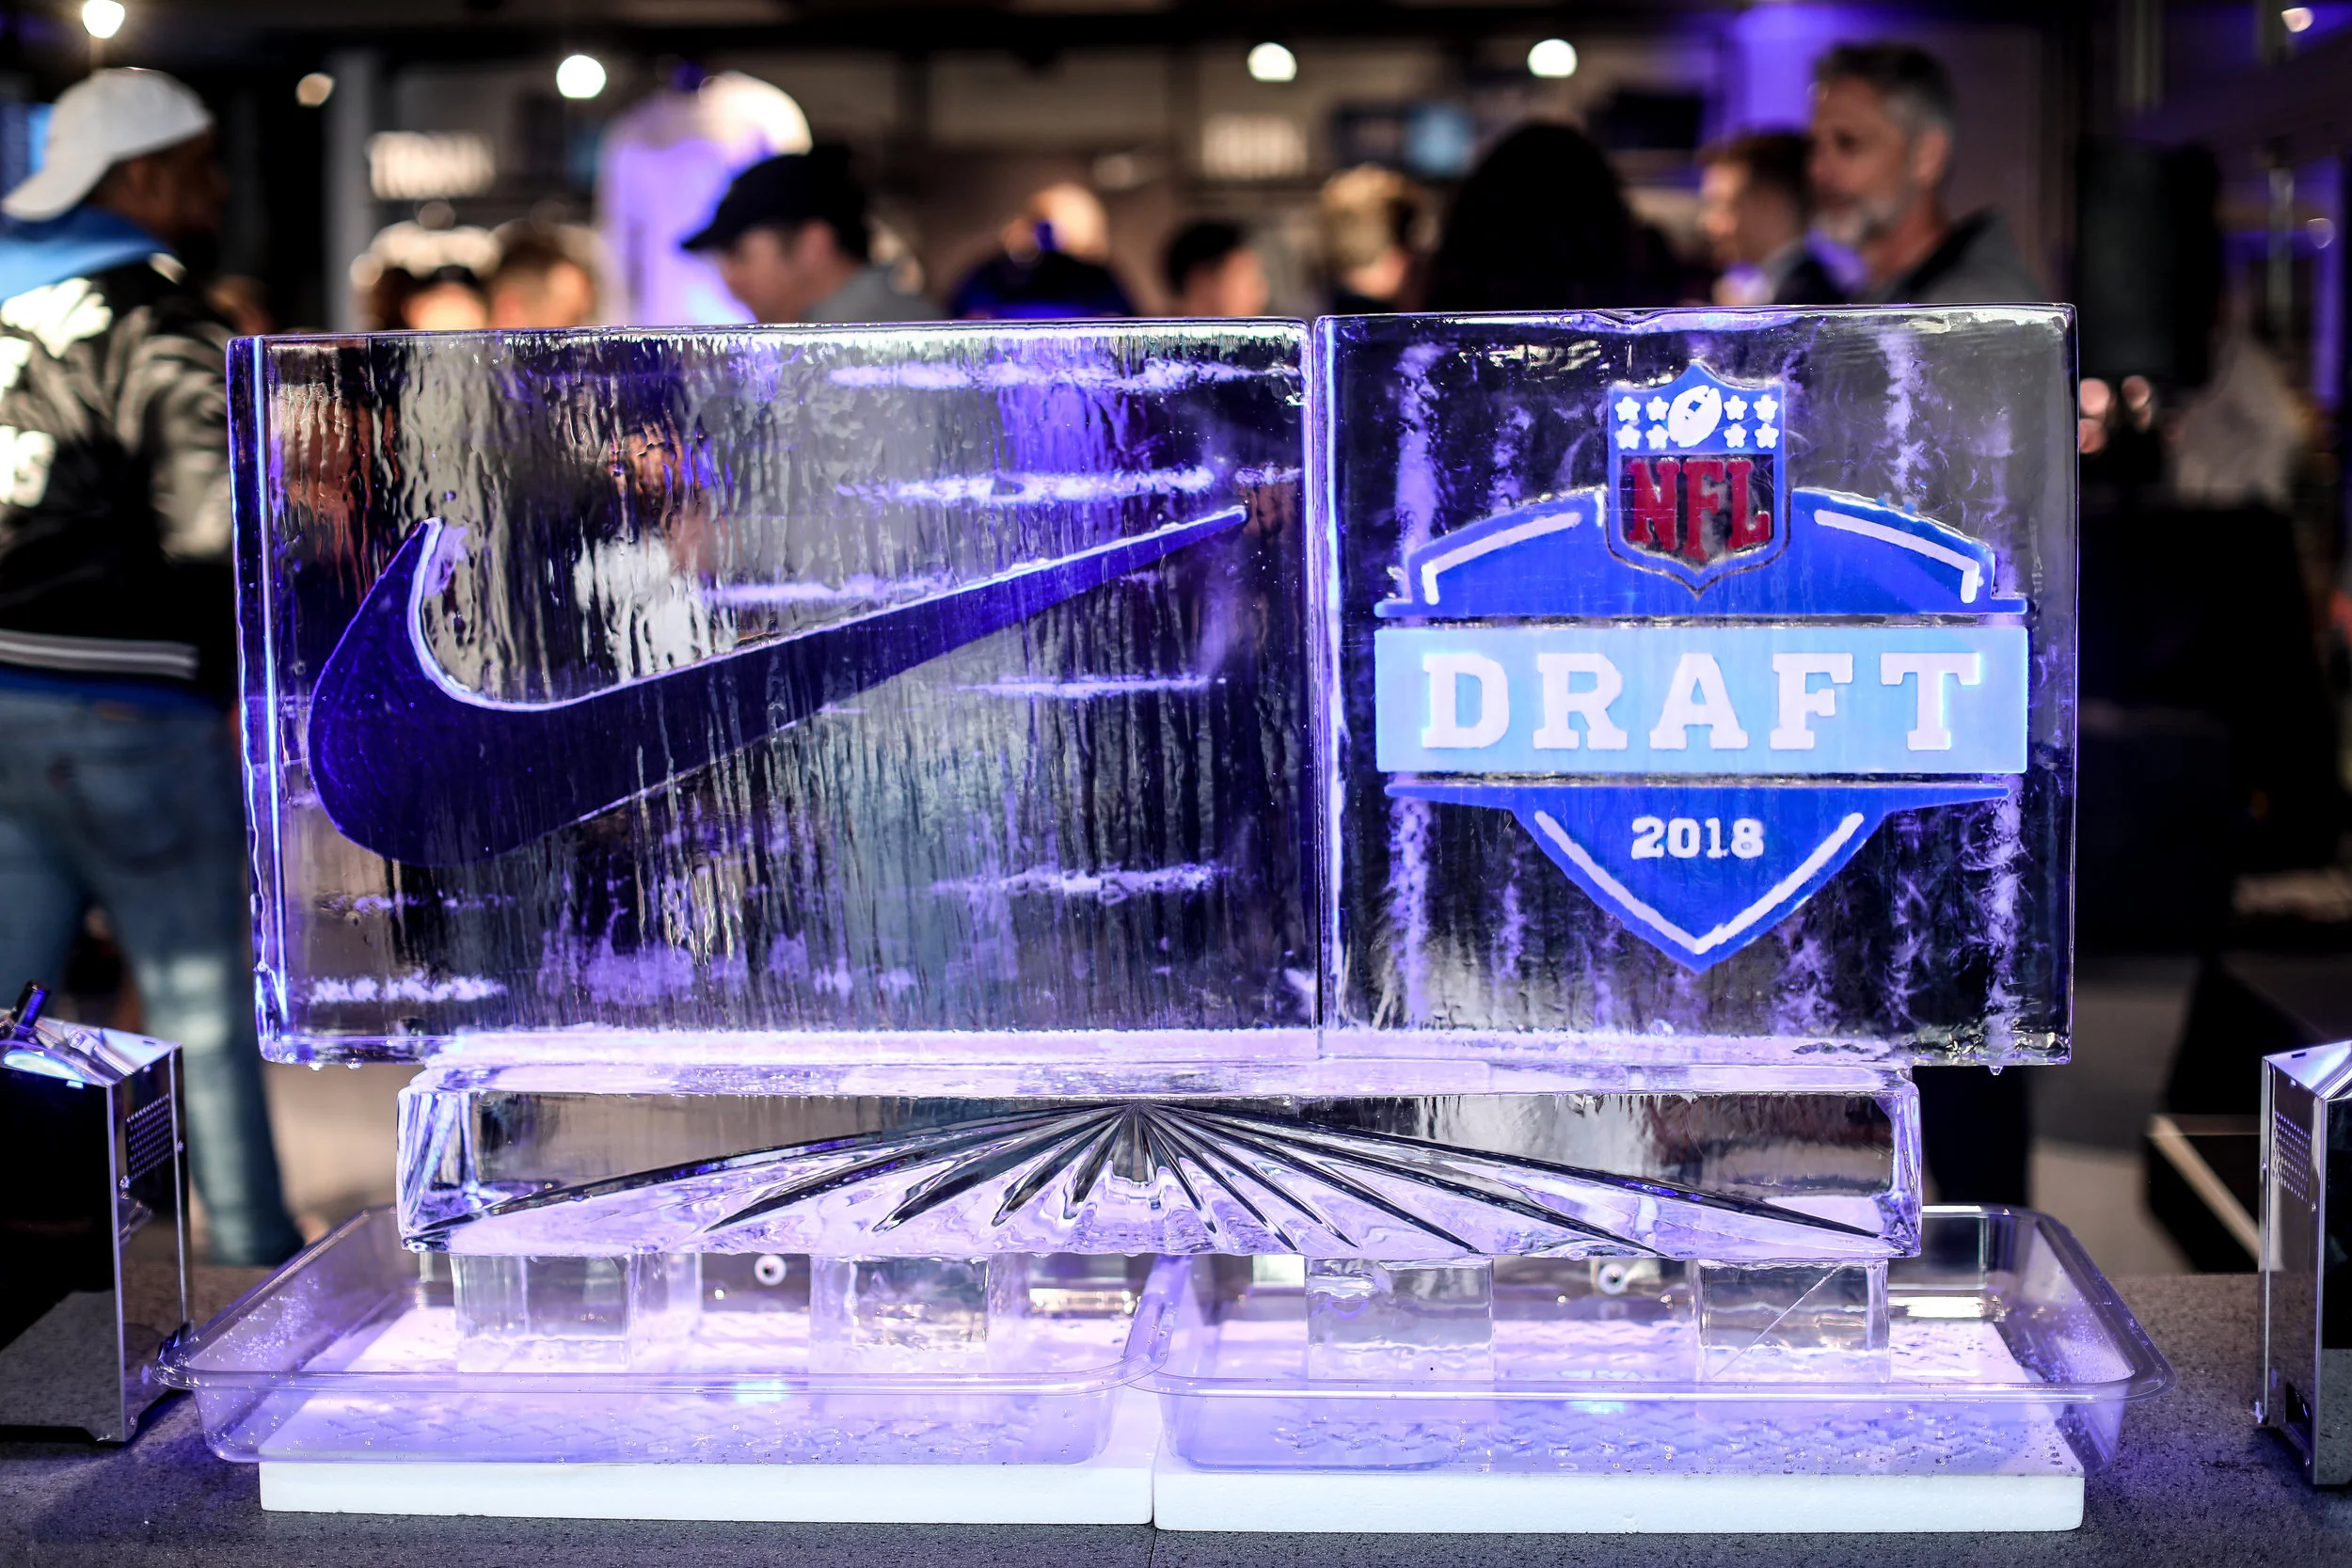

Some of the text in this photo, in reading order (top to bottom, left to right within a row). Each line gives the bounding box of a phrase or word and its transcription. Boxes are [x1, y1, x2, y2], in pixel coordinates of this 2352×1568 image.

[1628, 457, 1772, 562] NFL
[1422, 652, 1981, 751] DRAFT
[1630, 816, 1765, 860] 2018
